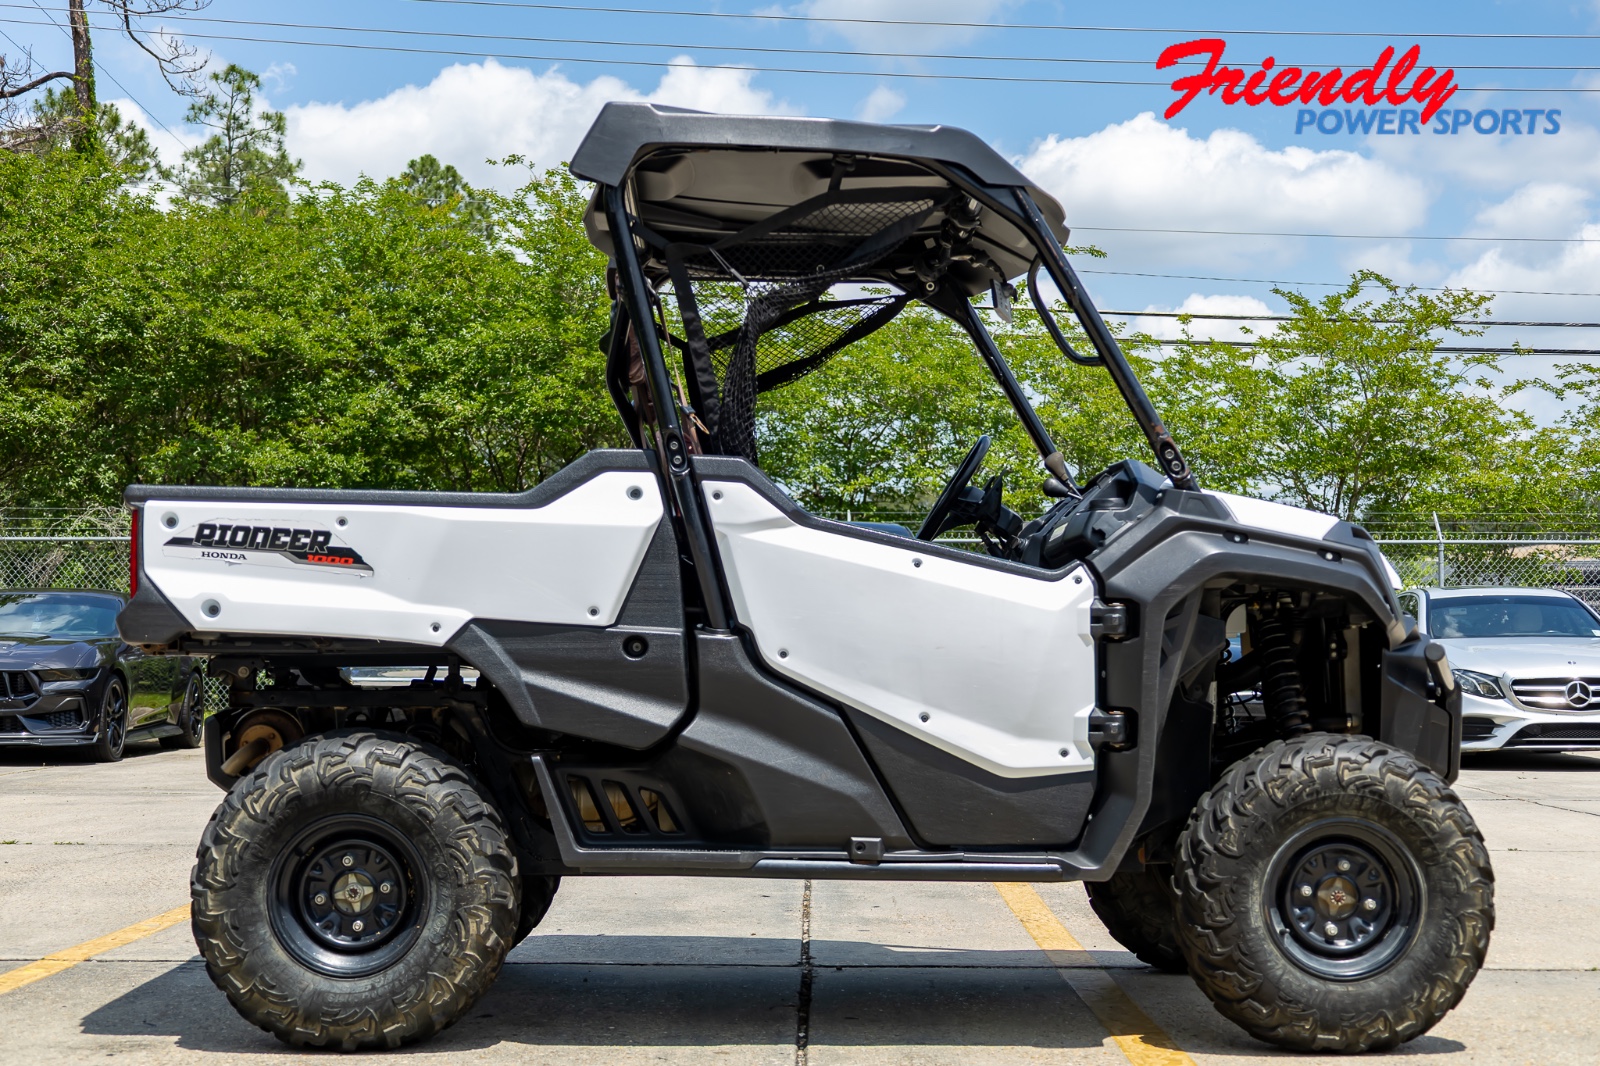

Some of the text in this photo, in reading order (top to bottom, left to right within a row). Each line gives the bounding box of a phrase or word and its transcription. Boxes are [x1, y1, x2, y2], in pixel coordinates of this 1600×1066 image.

[193, 523, 332, 553] PIONEER
[201, 551, 247, 560] HONDA
[307, 554, 354, 565] 1000
